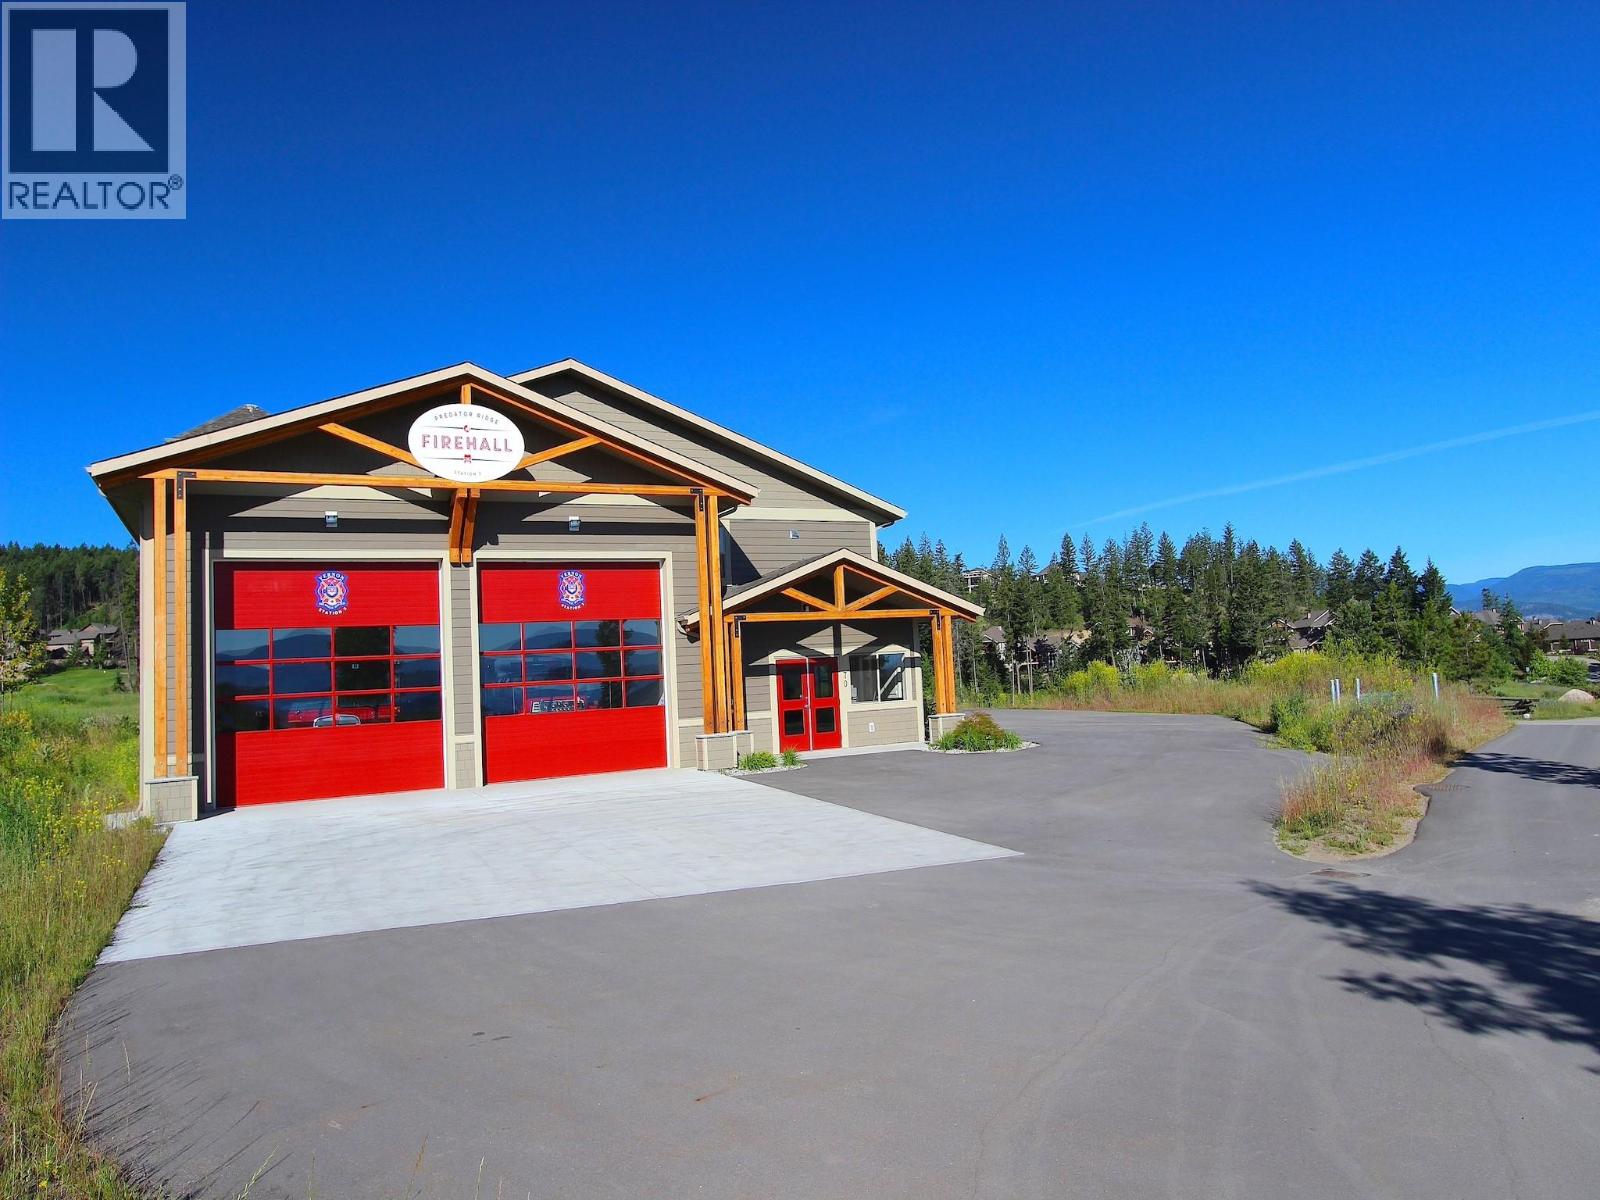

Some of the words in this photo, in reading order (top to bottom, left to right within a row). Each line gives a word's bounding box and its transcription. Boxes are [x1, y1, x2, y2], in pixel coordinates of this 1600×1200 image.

[434, 411, 473, 421] PREDATOR
[476, 413, 499, 424] RIDGE
[421, 434, 513, 452] FIREHALL
